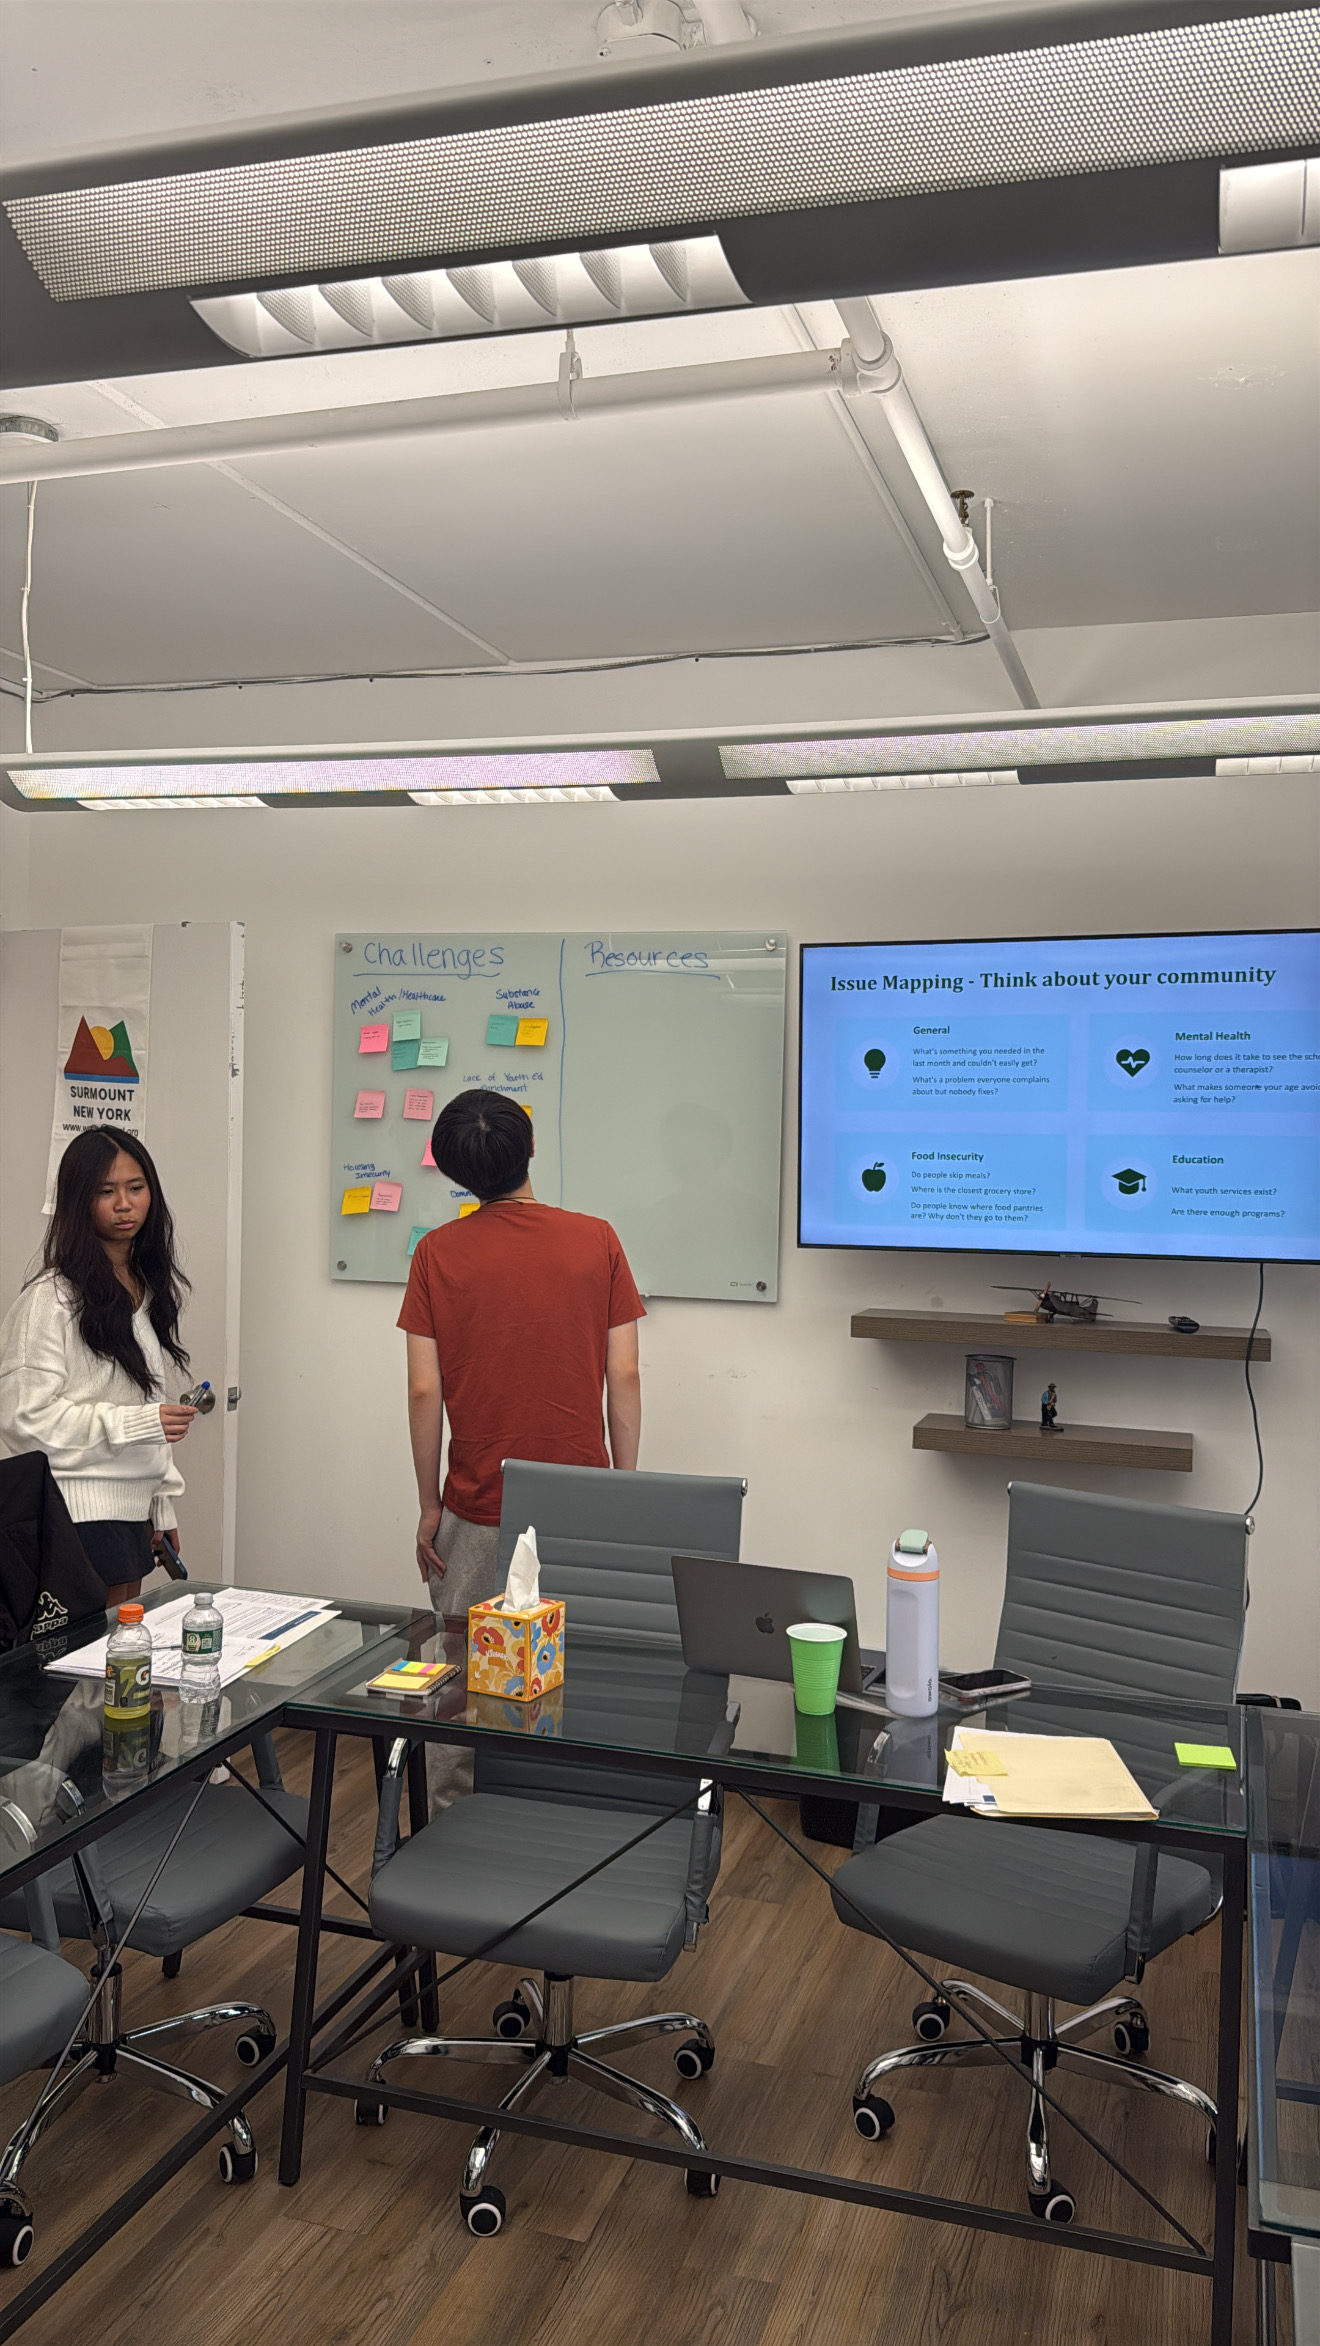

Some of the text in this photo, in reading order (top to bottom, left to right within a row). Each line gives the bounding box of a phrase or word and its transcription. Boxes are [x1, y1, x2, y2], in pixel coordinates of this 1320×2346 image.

[585, 940, 709, 968] Resources
[364, 942, 505, 980] Challenges
[831, 976, 877, 991] Issue
[883, 974, 964, 994] Mapping
[979, 971, 1038, 988] Think
[1042, 971, 1100, 987] about
[1104, 973, 1152, 990] your
[1157, 966, 1277, 986] community
[496, 988, 540, 1000] Substance
[350, 986, 382, 1014] Mental
[368, 994, 397, 1016] Health
[508, 1001, 535, 1009] Abuse
[913, 1025, 950, 1034] General
[1175, 1031, 1251, 1041] Mental Health
[939, 1047, 978, 1056] something
[1194, 1053, 1212, 1062] long
[998, 1059, 1020, 1068] easily
[1021, 1059, 1038, 1068] get?
[1173, 1066, 1214, 1074] counselor
[1232, 1065, 1274, 1074] therapist?
[488, 1072, 496, 1081] of
[532, 1072, 544, 1080] Ed
[945, 1076, 975, 1084] problem
[1012, 1076, 1050, 1084] complains
[70, 1086, 134, 1102] SURMOUNT
[948, 1088, 977, 1096] nobody
[1173, 1096, 1199, 1104] asking
[1213, 1095, 1236, 1104] help?
[74, 1105, 131, 1121] NEW YORK
[911, 1151, 984, 1163] Food Insecurity
[1172, 1154, 1224, 1164] Education
[922, 1171, 948, 1179] people
[949, 1171, 964, 1180] skip
[910, 1185, 935, 1193] Where
[983, 1188, 1012, 1196] grocery
[1013, 1187, 1036, 1195] store?
[1194, 1186, 1218, 1196] youth
[922, 1202, 948, 1211] people
[948, 1202, 969, 1210] know
[970, 1202, 993, 1211] where
[994, 1203, 1012, 1211] food
[1013, 1205, 1044, 1213] pantries
[927, 1212, 945, 1222] Why
[945, 1212, 965, 1221] don't
[966, 1213, 983, 1222] they
[1209, 1209, 1240, 1218] enough
[1242, 1210, 1286, 1219] programs?
